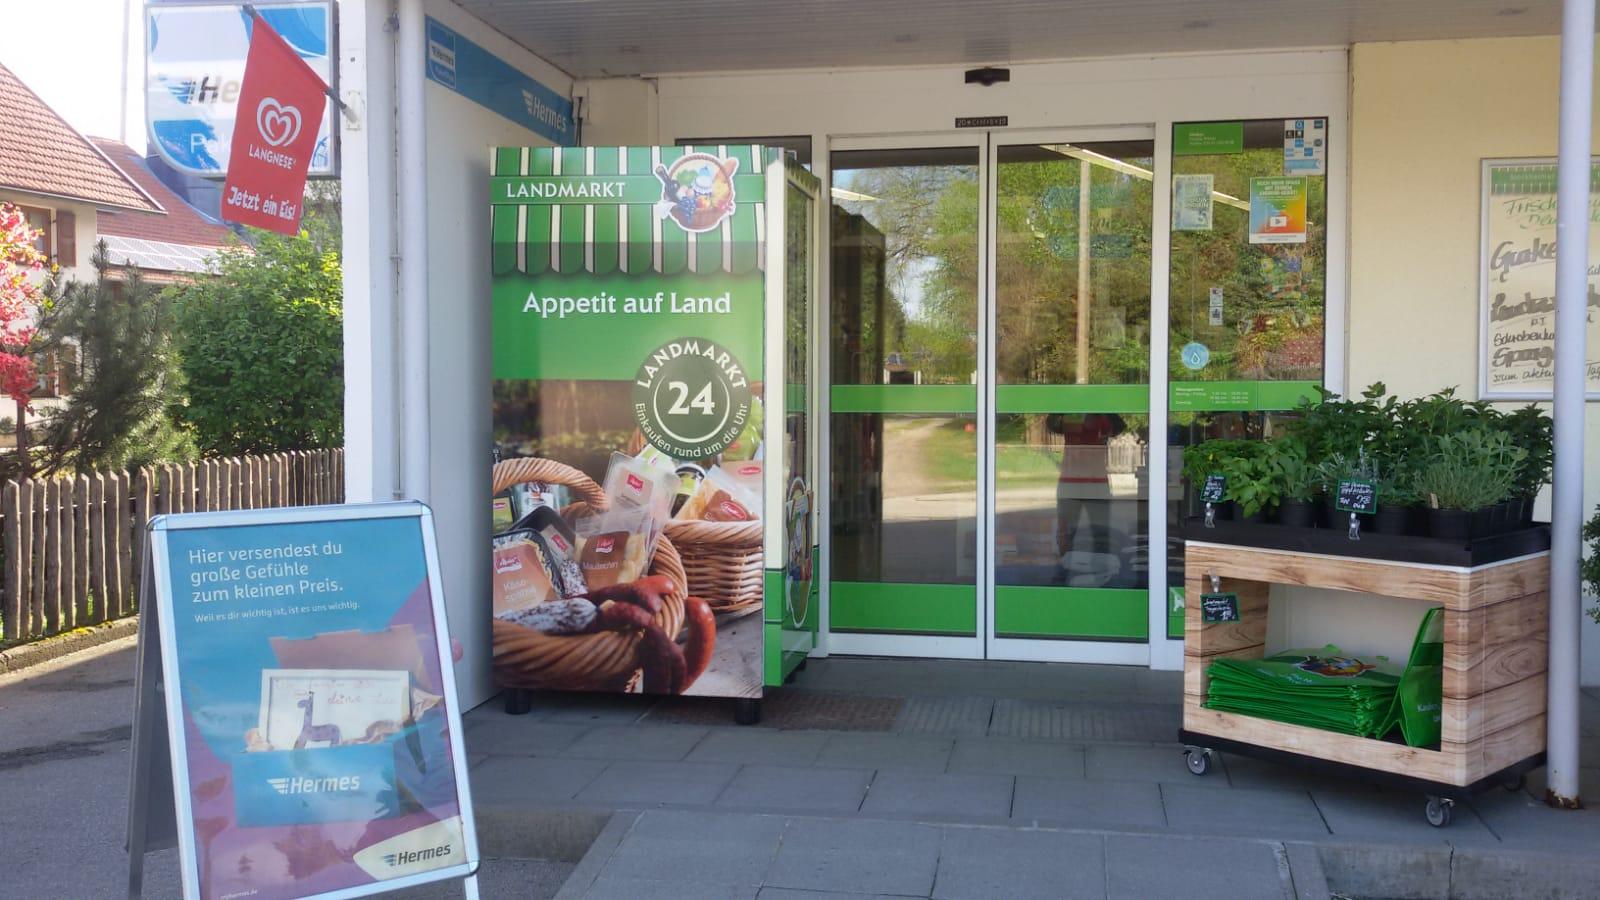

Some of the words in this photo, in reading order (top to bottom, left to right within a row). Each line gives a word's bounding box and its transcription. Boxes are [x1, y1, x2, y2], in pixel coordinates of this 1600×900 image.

[199, 75, 240, 105] He
[532, 96, 567, 132] Hermes
[249, 144, 293, 170] LANGNESE
[507, 182, 626, 198] LANDMARKT
[227, 186, 260, 211] Jetzt
[263, 195, 277, 216] ein
[279, 200, 297, 221] Eis!
[1490, 238, 1557, 283] Gurke
[522, 291, 616, 318] Appetit
[623, 291, 664, 314] auf
[670, 291, 732, 314] Land
[637, 340, 747, 389] LANDMARKT
[1492, 346, 1555, 368] Sparg
[668, 381, 715, 415] 24
[635, 402, 671, 452] Einkaufen
[673, 446, 702, 458] rund
[704, 442, 722, 455] um
[723, 427, 739, 444] die
[733, 403, 748, 425] Uhr
[188, 549, 224, 564] Hier
[229, 543, 319, 561] versendest
[322, 541, 343, 555] du
[191, 567, 241, 587] große
[245, 562, 309, 580] Gefühle
[192, 588, 229, 603] zum
[234, 582, 295, 600] kleinen
[299, 578, 344, 595] Preis.
[194, 613, 214, 623] Weil
[227, 610, 239, 621] dir
[241, 607, 273, 619] wichtig
[273, 607, 287, 616] ist,
[288, 606, 300, 615] ist
[301, 605, 311, 613] es
[312, 604, 327, 612] uns
[328, 600, 361, 611] wichtig.
[290, 775, 361, 794] Hermes
[397, 843, 452, 866] Hermes
